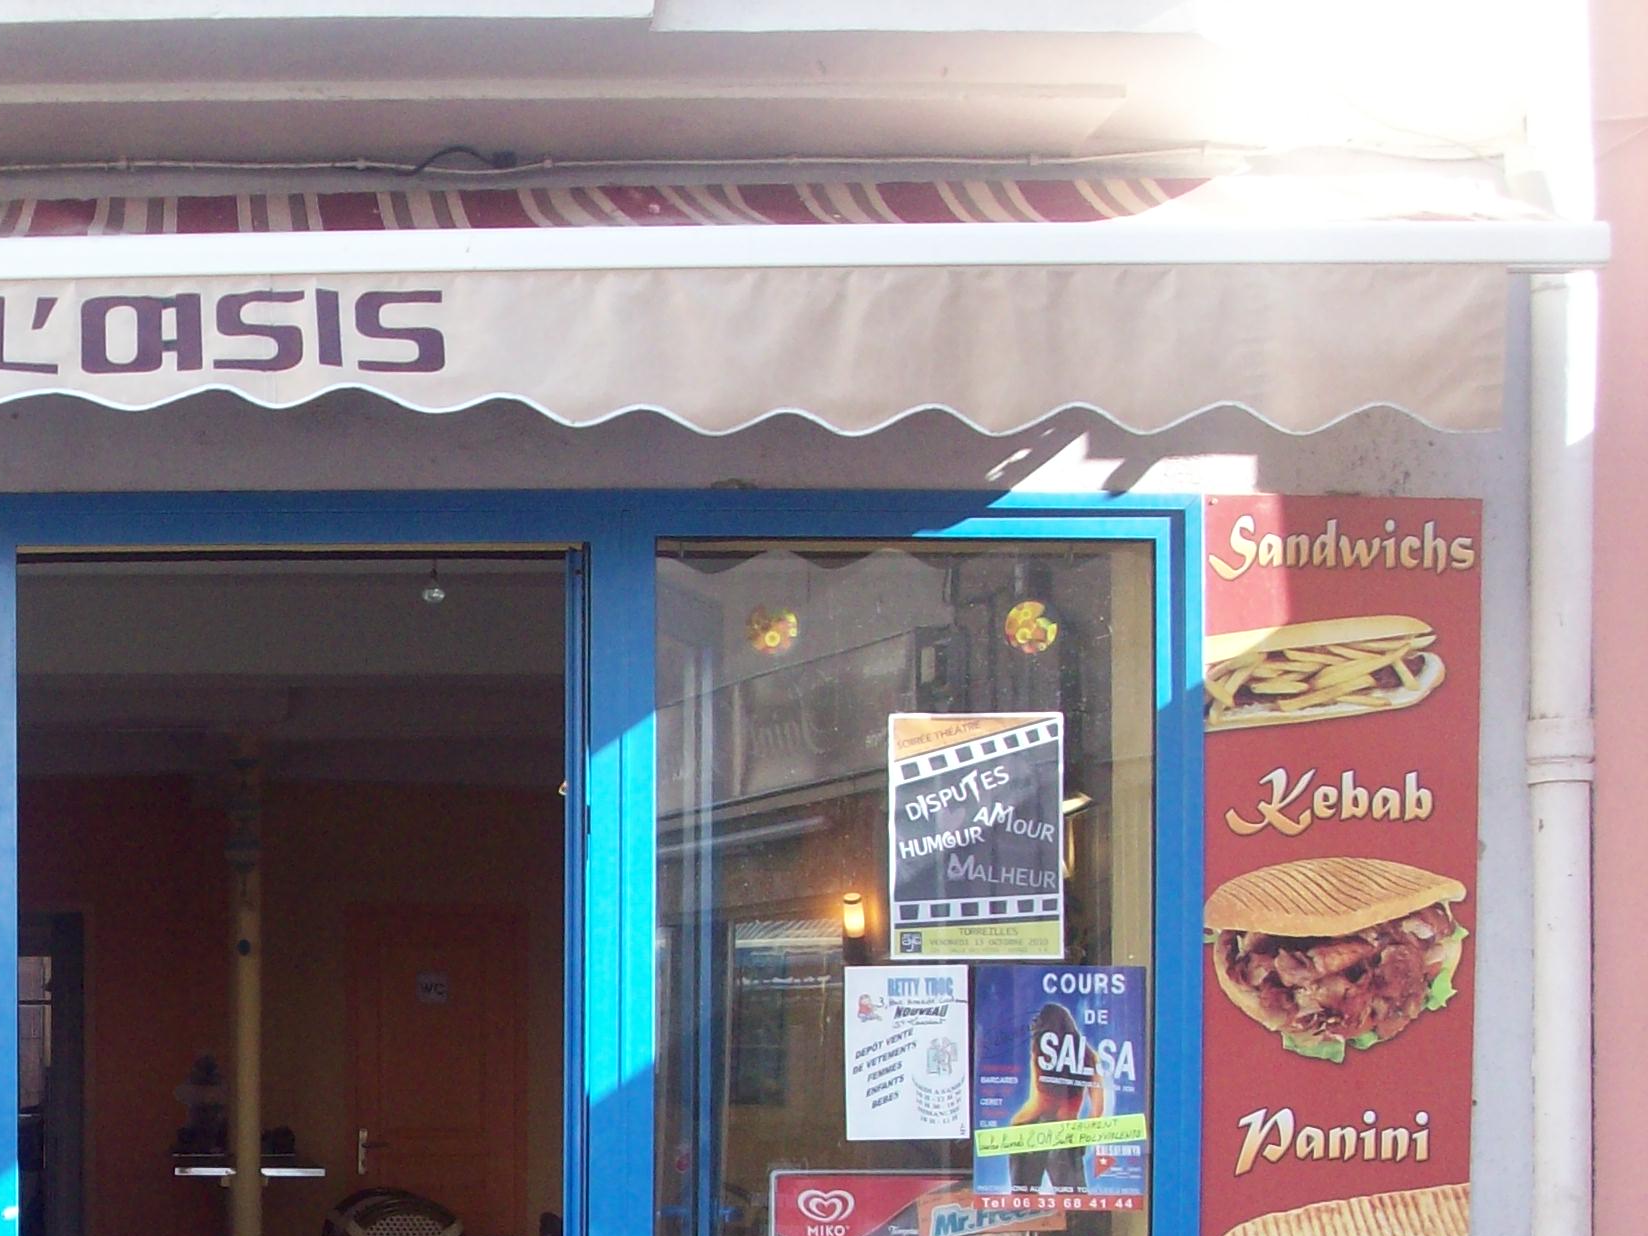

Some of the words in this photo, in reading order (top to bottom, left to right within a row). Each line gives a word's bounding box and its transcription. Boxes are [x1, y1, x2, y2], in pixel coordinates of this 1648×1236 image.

[1208, 514, 1476, 582] Sandwichs
[903, 765, 1010, 822] DISPUTES
[1224, 767, 1435, 836] Kebab
[972, 801, 1055, 843] AMOUR
[898, 825, 985, 859] HUMOUR
[946, 852, 1057, 889] MALHEUR
[1041, 972, 1127, 995] COURS
[893, 1003, 949, 1020] NOUVEAU
[1083, 1009, 1109, 1025] DE
[866, 1060, 904, 1083] FEMMES
[1037, 1030, 1137, 1082] SALSA
[1233, 1106, 1431, 1177] Panini
[982, 1197, 1005, 1208] Tel
[1013, 1197, 1031, 1208] 06
[1037, 1197, 1056, 1208] 33
[1063, 1197, 1082, 1208] 68
[1089, 1197, 1107, 1208] 41
[1114, 1197, 1134, 1208] 44
[935, 1212, 975, 1236] Mr.
